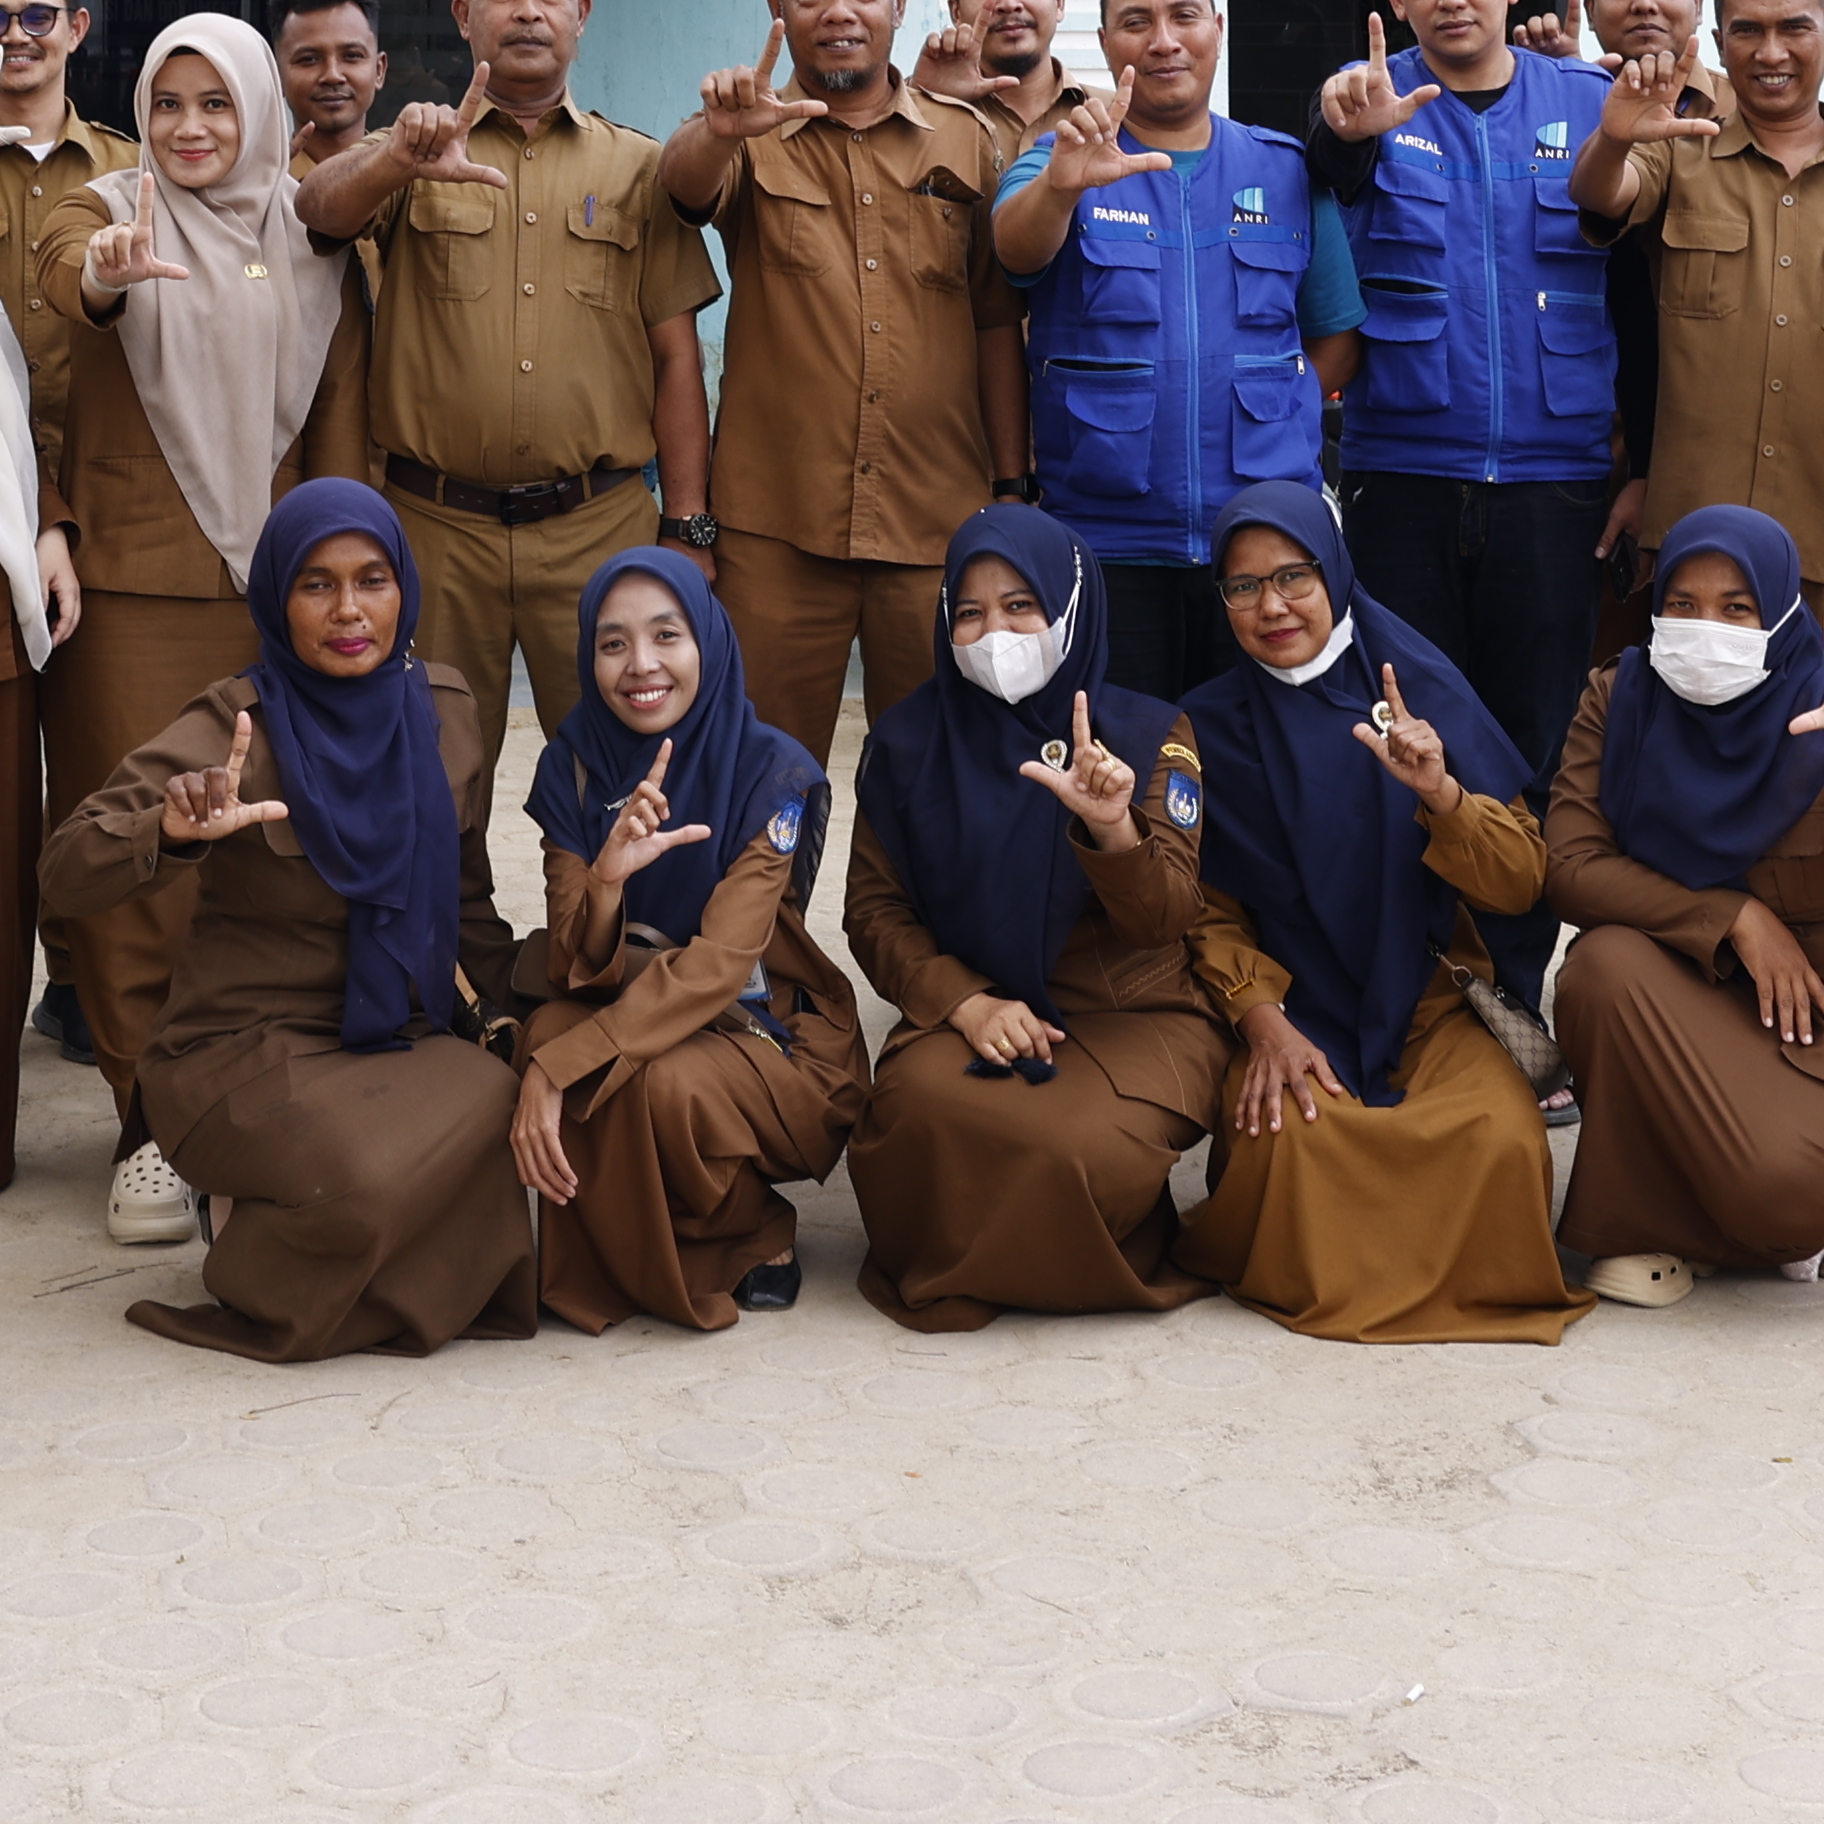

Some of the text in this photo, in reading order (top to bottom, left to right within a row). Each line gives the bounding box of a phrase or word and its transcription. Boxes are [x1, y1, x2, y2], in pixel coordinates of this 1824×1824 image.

[1394, 132, 1443, 156] ARIZAL
[1534, 147, 1570, 159] ANRI
[1093, 206, 1150, 226] FARHAN
[1233, 213, 1269, 225] ANRI
